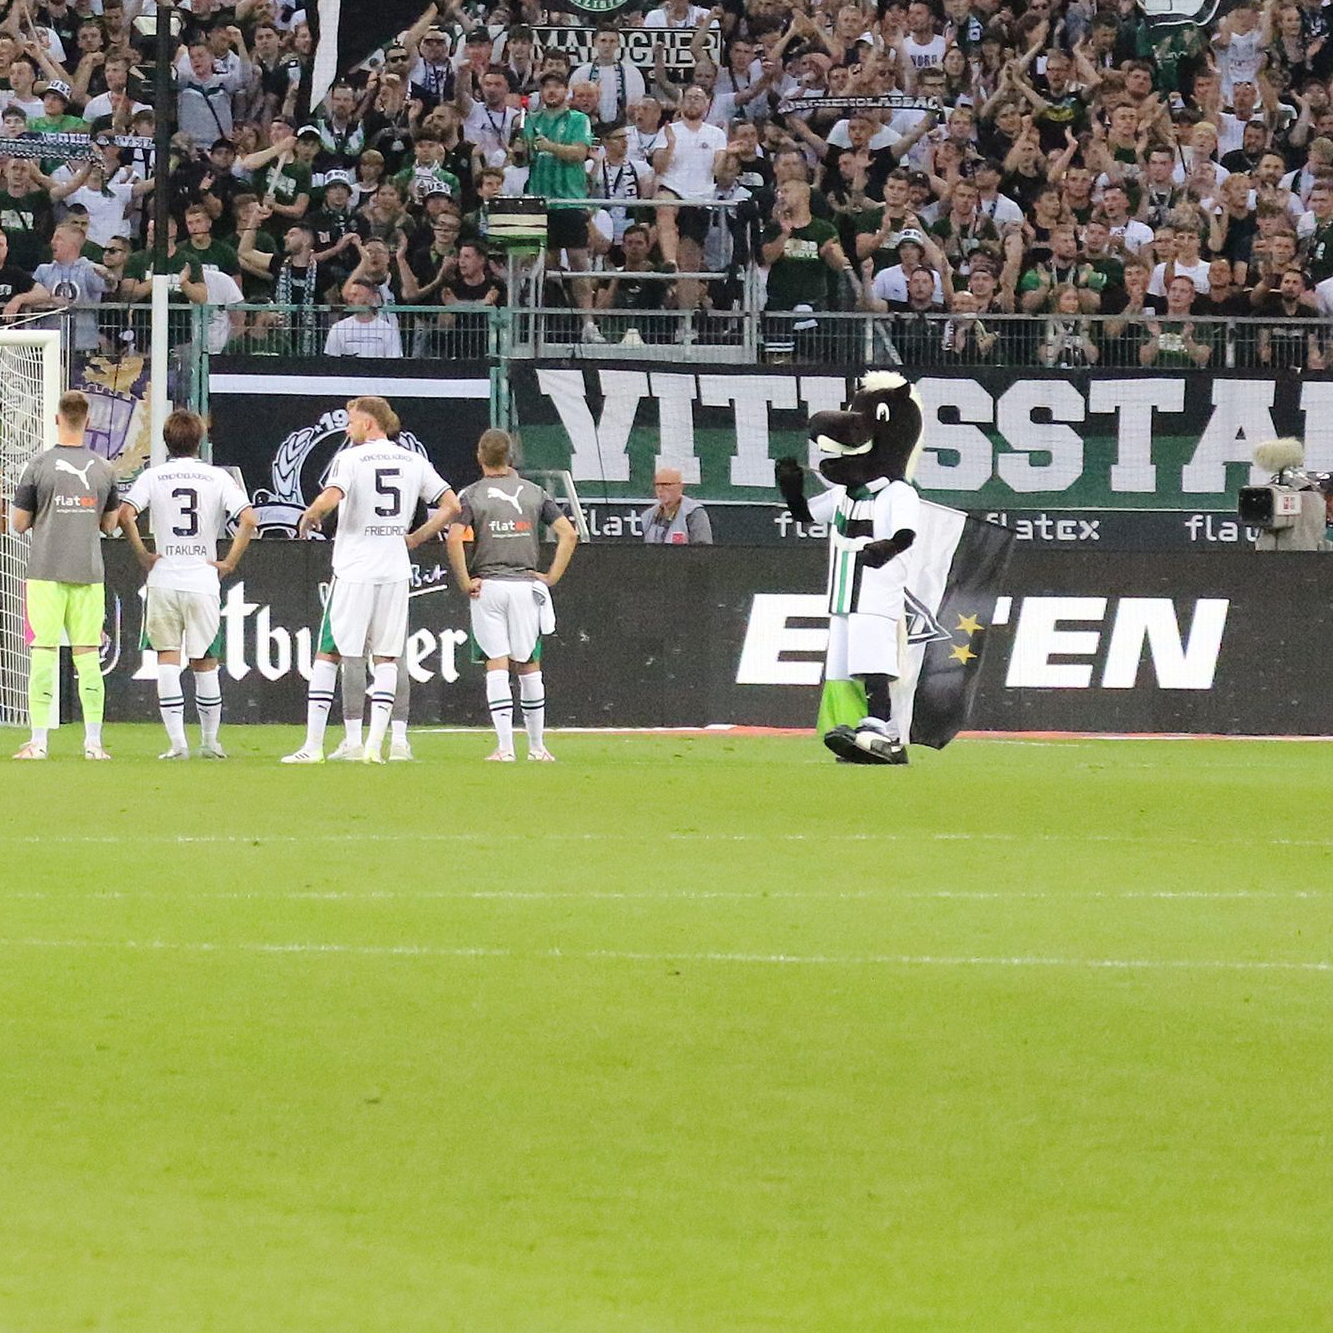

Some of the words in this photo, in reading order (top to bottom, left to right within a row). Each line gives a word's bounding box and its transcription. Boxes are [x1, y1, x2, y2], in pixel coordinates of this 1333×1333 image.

[538, 368, 1333, 482] VITSSTA
[171, 487, 199, 537] 3
[374, 467, 401, 518] 5
[165, 544, 208, 556] ITAKURA
